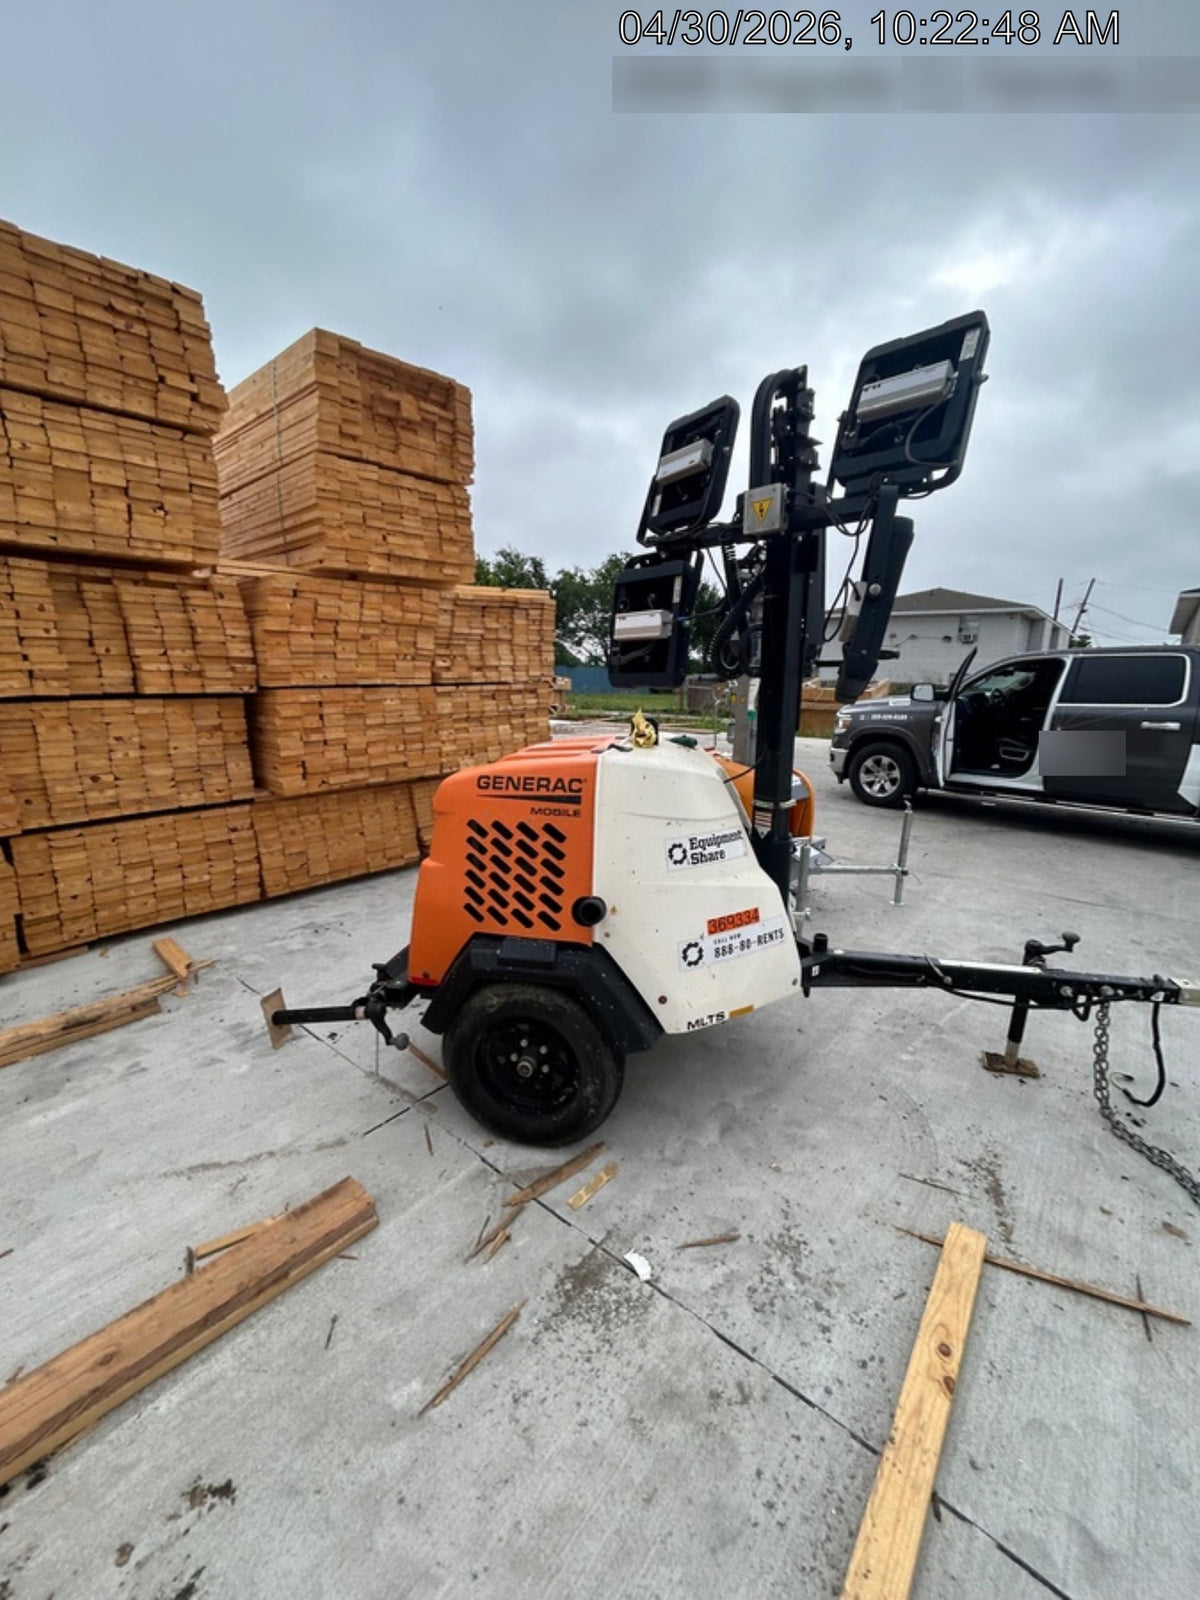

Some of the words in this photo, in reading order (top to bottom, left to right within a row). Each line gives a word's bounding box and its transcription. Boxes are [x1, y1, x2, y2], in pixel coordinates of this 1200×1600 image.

[476, 774, 583, 794] GENERAC
[529, 806, 582, 818] MOBILE
[688, 829, 744, 850] Equipment
[690, 849, 726, 865] Share
[707, 907, 760, 935] 369334
[713, 927, 785, 959] 888-80-RENTS
